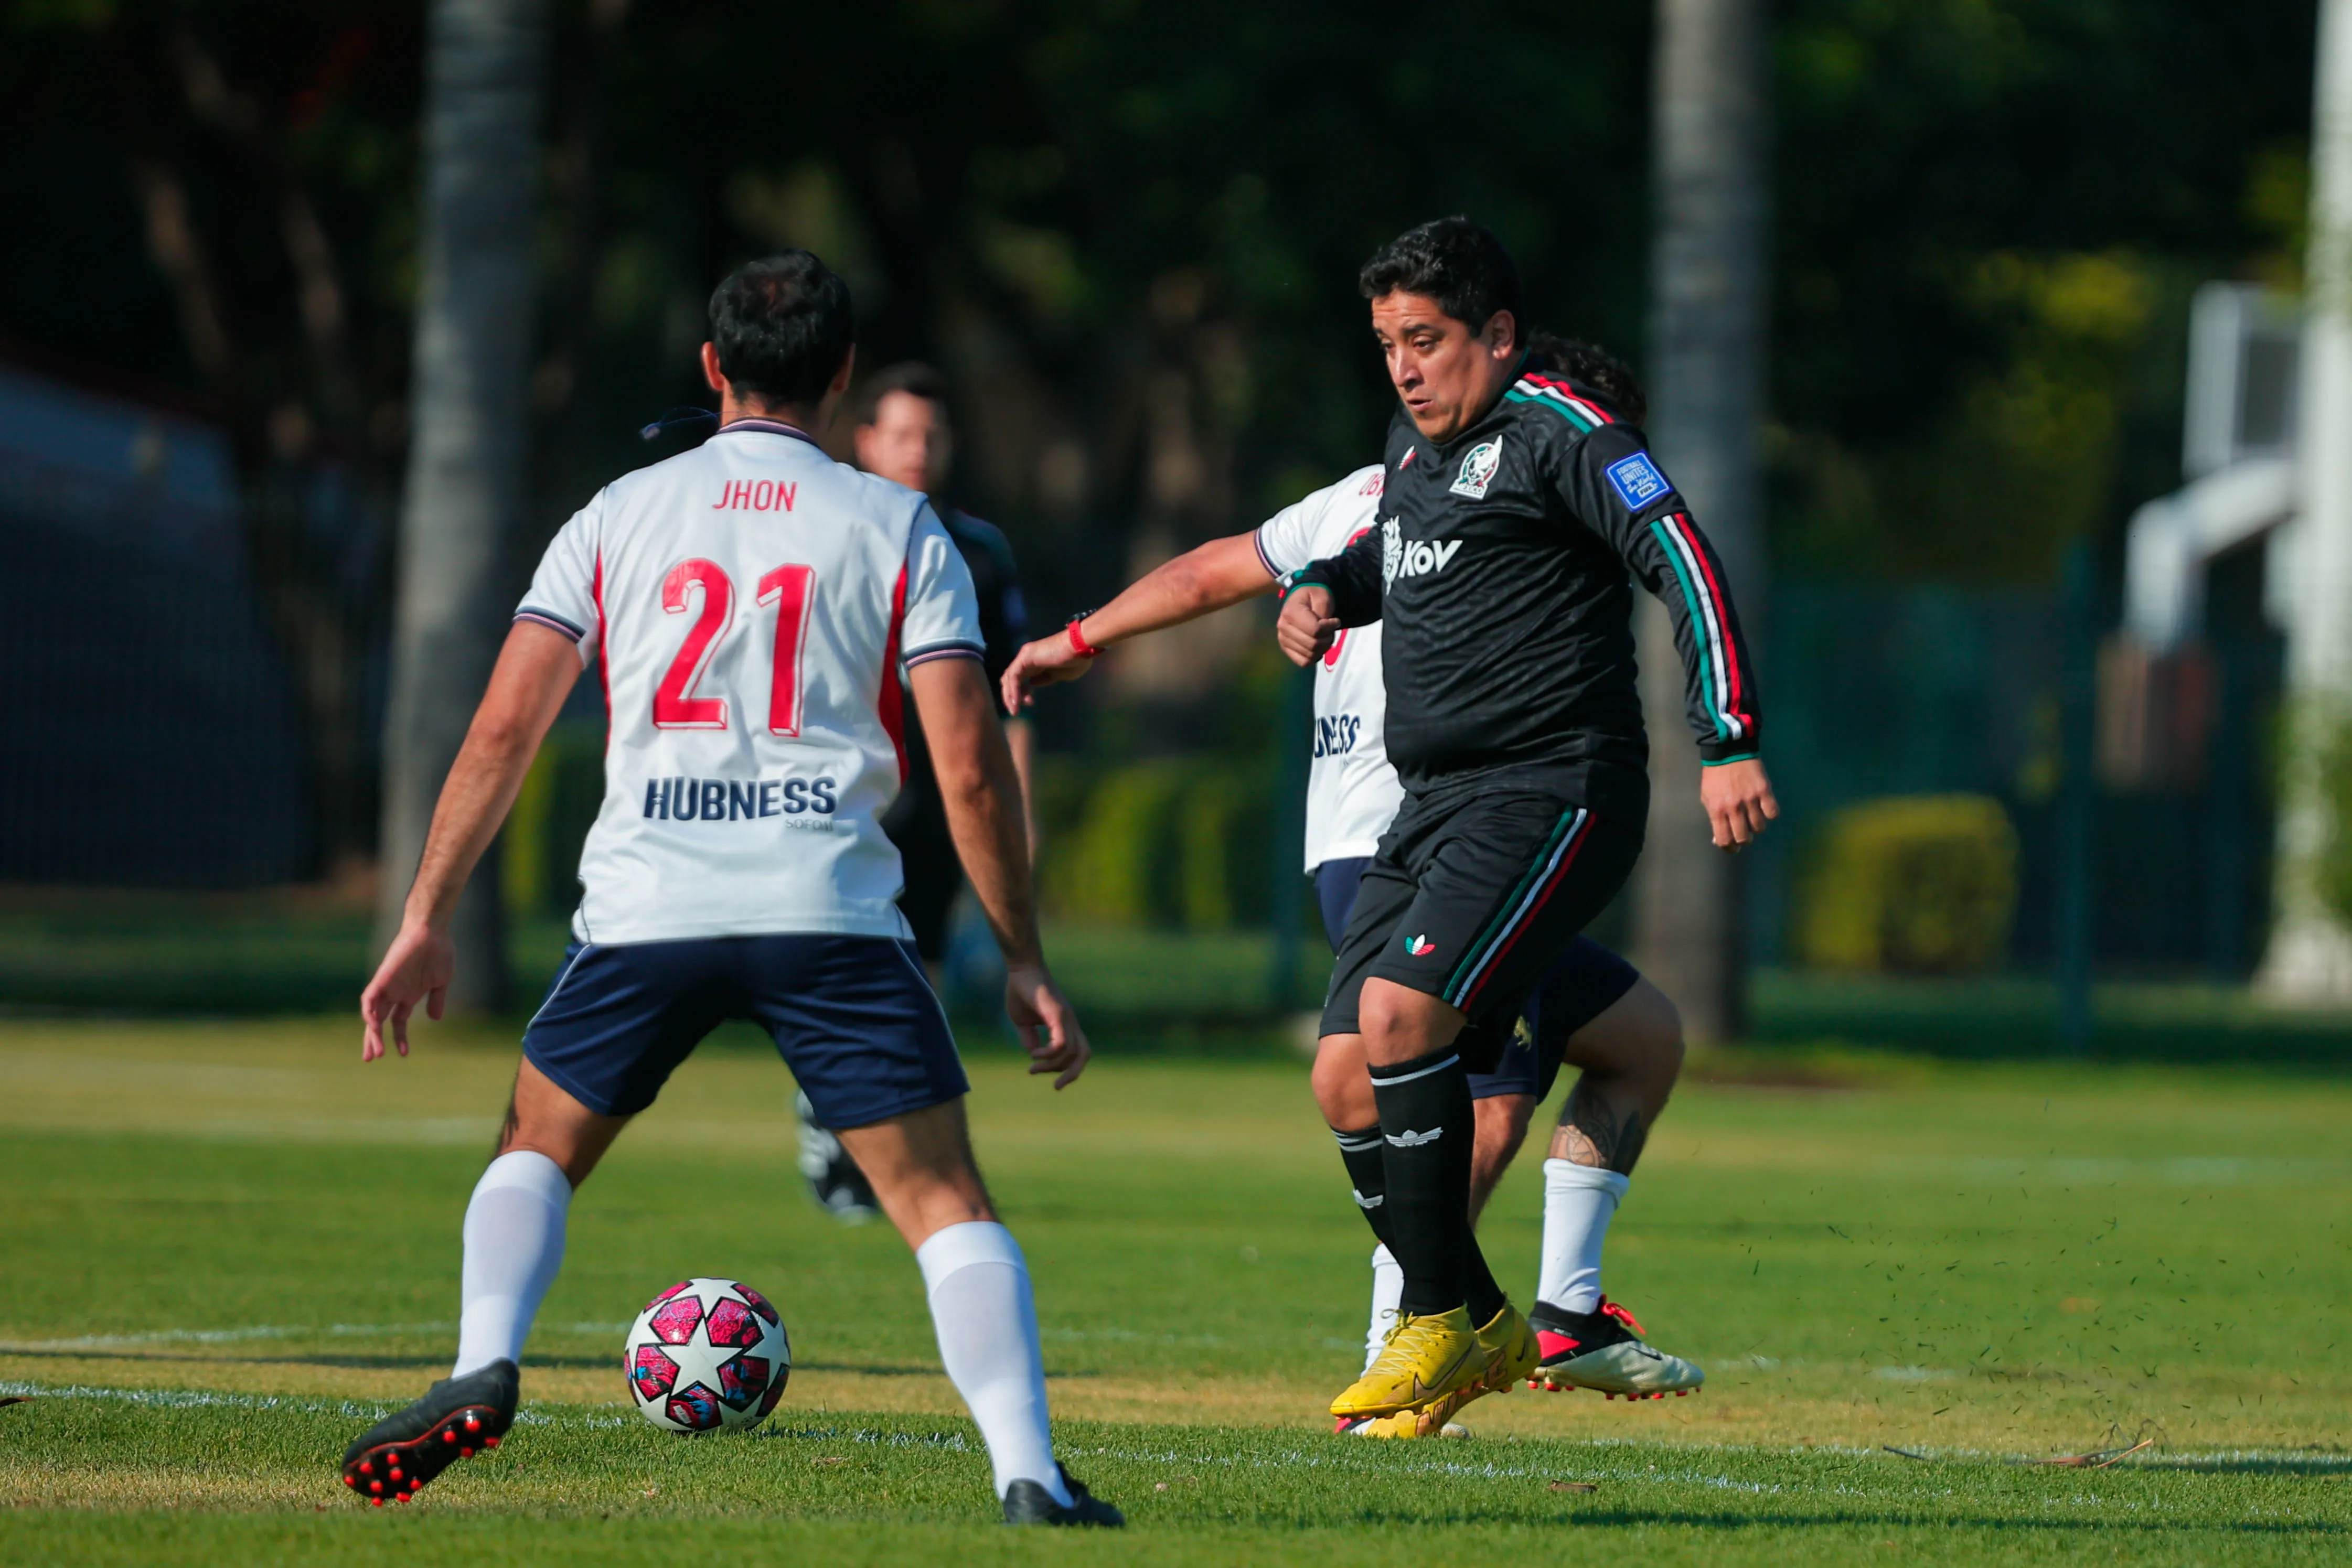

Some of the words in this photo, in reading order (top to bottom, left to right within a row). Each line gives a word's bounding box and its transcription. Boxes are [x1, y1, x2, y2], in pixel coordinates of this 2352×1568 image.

[1621, 465, 1649, 485] UNITES
[712, 479, 798, 512] JHON
[653, 557, 816, 737] 21
[643, 776, 837, 821] HUBNESS
